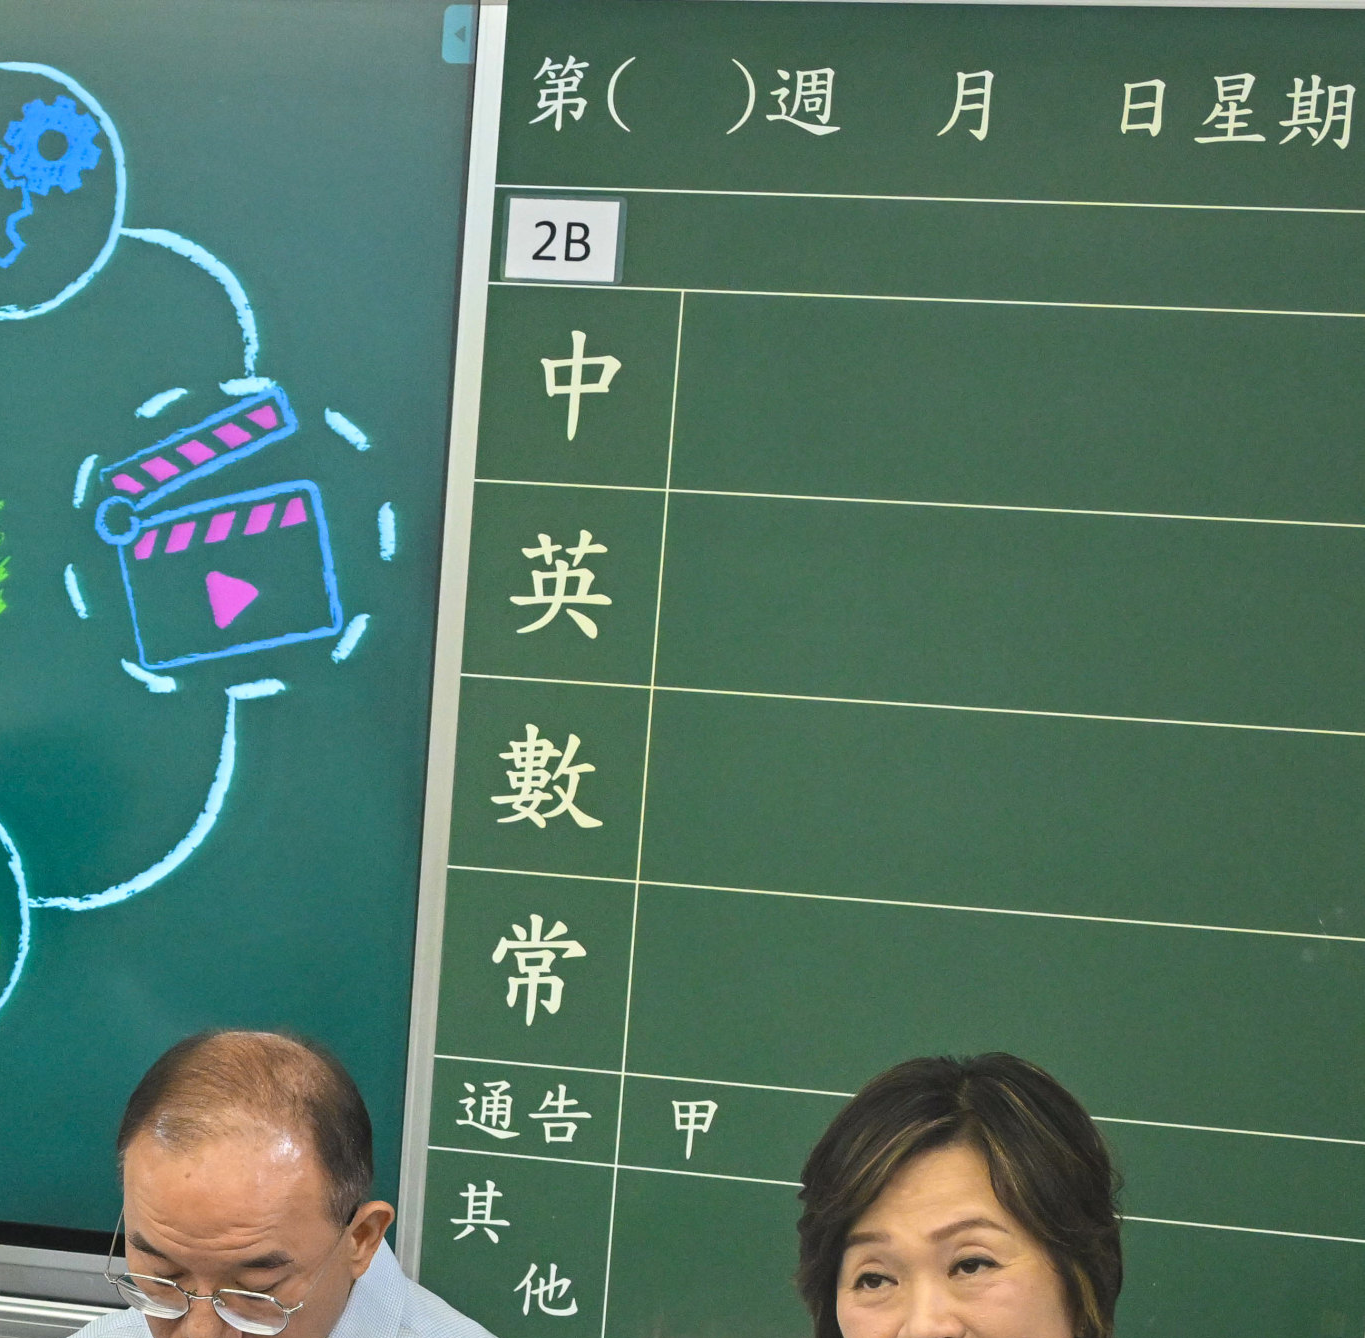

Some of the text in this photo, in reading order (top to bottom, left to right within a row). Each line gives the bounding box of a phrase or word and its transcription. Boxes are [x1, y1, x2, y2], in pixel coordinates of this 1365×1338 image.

[936, 69, 995, 142] 月
[531, 220, 593, 264] 2B
[539, 330, 622, 442] 中
[508, 529, 614, 640] 英
[491, 723, 604, 830] 數
[491, 913, 587, 1027] 常
[455, 1079, 593, 1144] 通告
[671, 1099, 719, 1160] 甲
